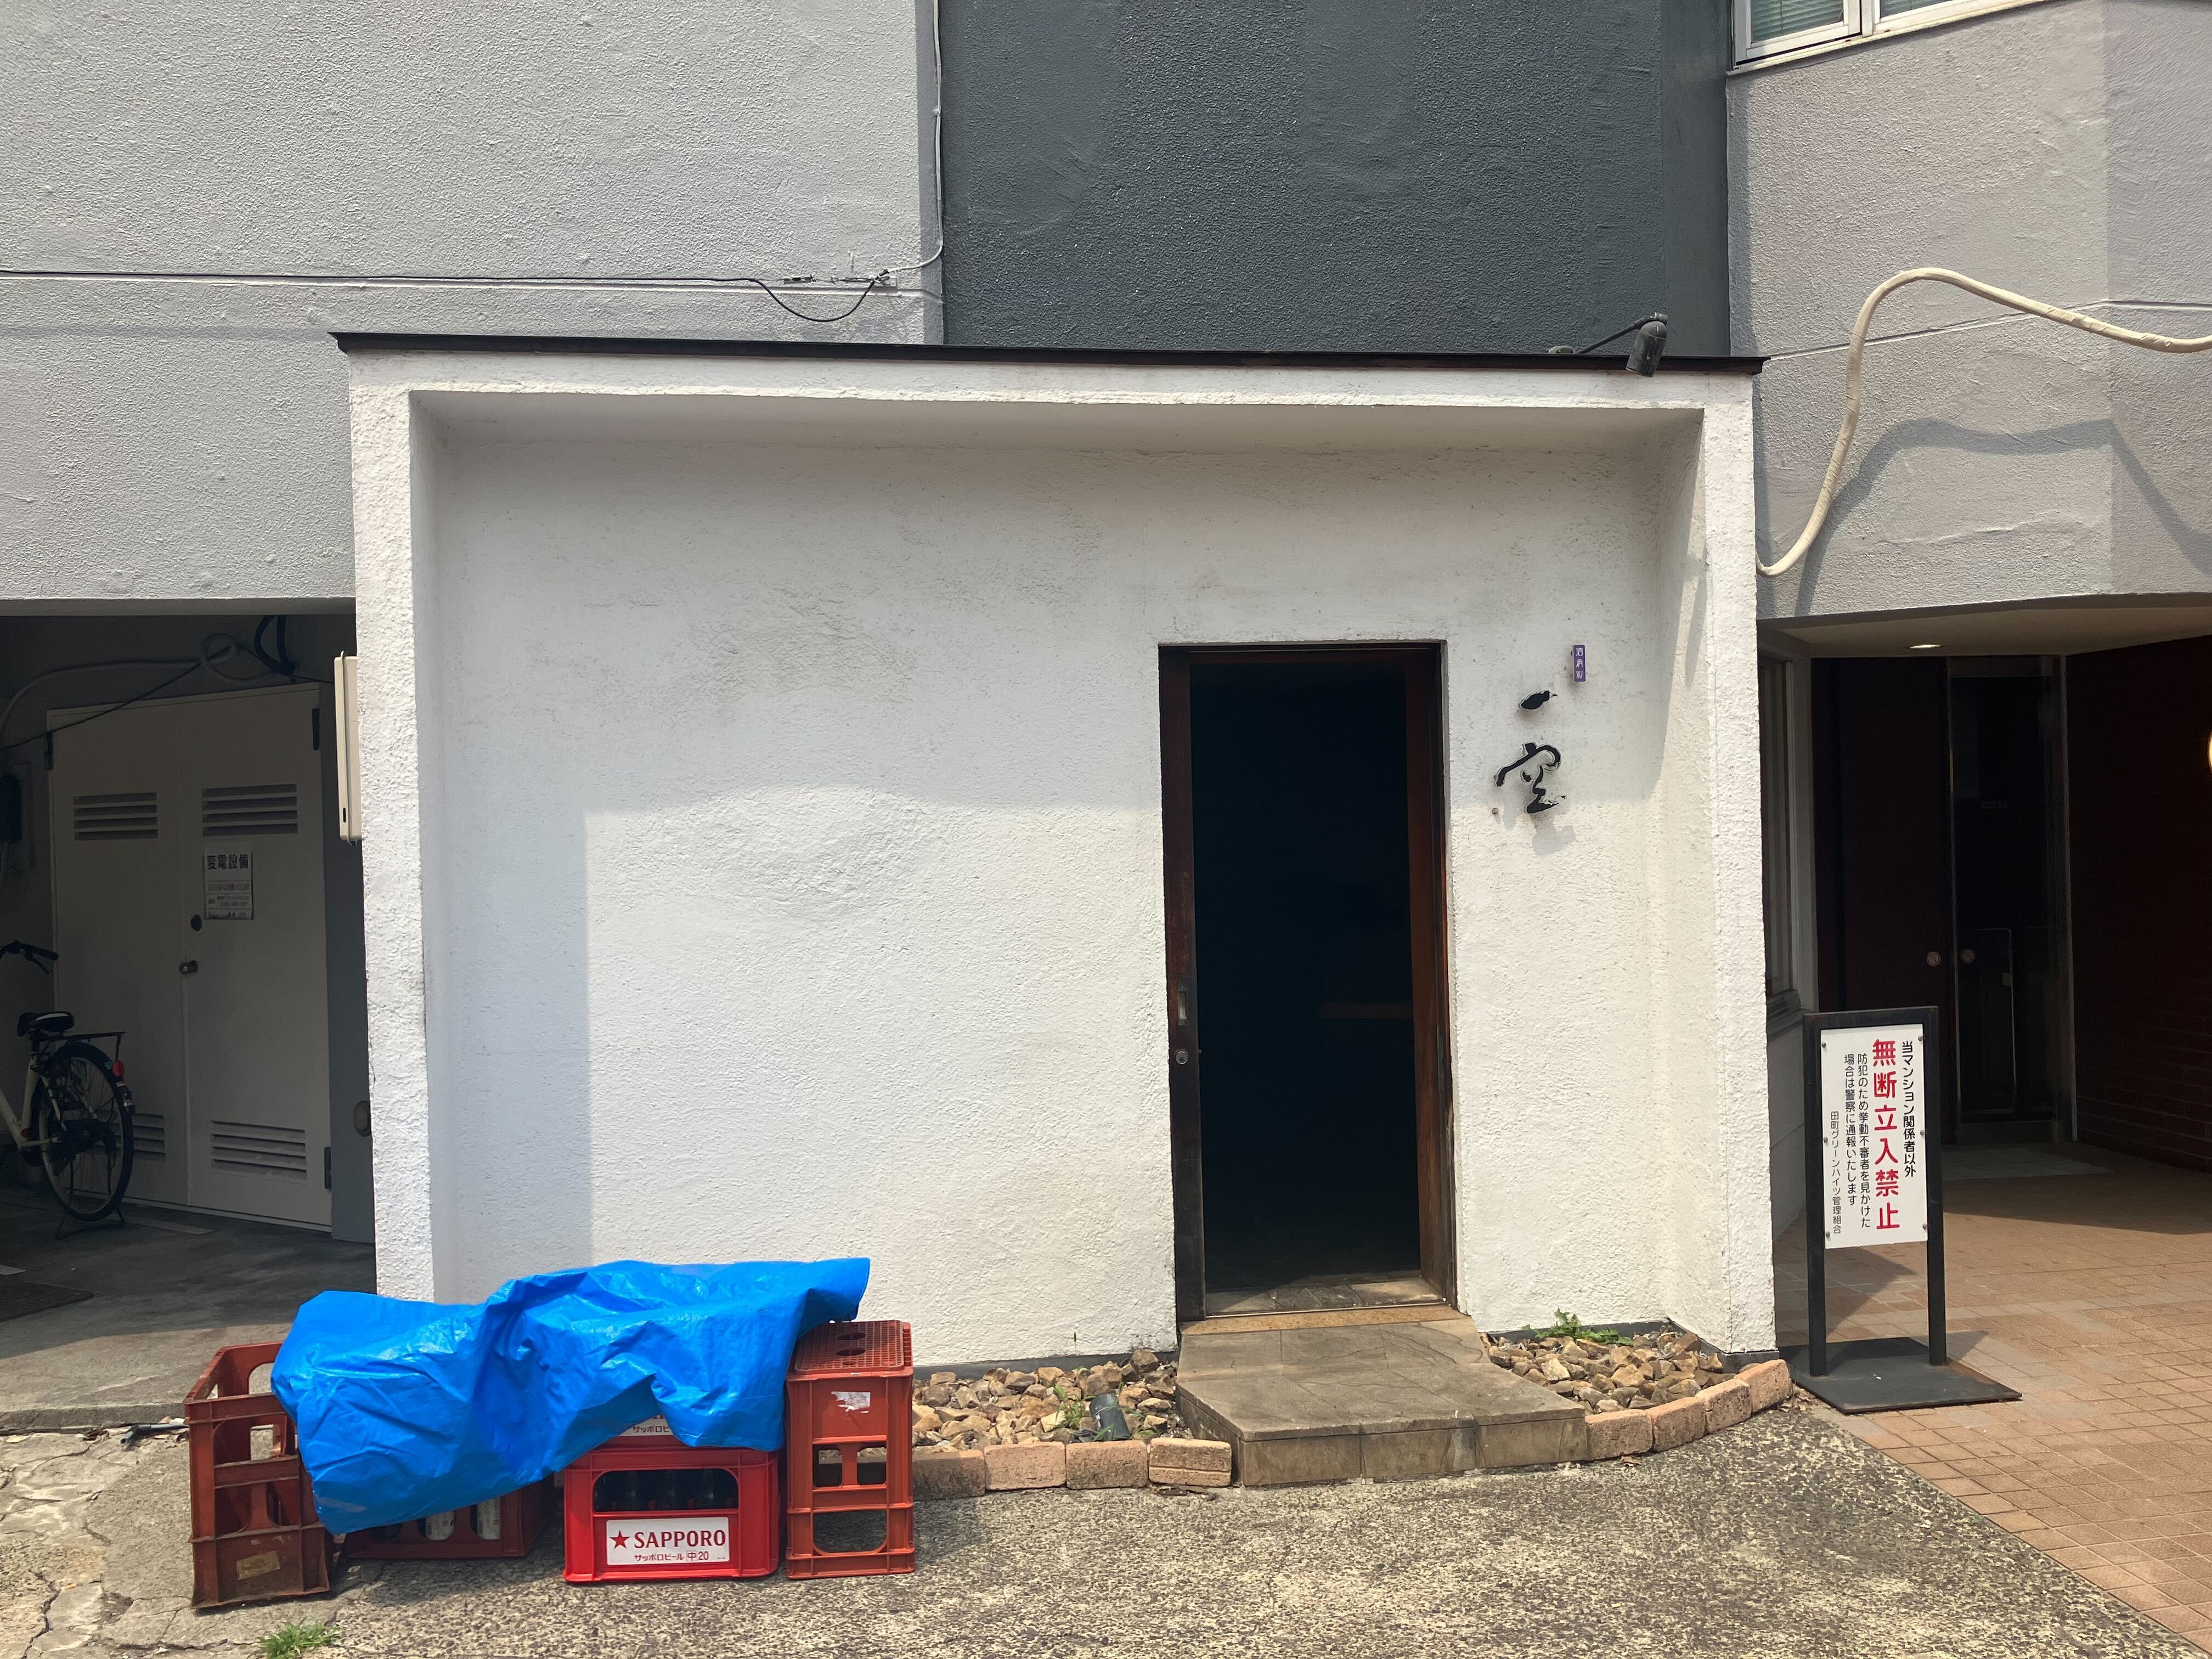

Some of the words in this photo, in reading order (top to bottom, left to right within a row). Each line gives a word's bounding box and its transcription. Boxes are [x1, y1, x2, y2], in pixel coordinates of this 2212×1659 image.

[1830, 1111, 1842, 1234] 田町グリーンハイツ管理組合
[1844, 1053, 1858, 1206] 場合は警察に通報いたします
[1857, 1053, 1871, 1228] 防犯のため挙動不審者を見かけた
[1872, 1039, 1900, 1230] 無断立入禁止
[1901, 1040, 1916, 1178] 当マンション関係者以外
[634, 1530, 726, 1548] SAPPORO
[634, 1553, 684, 1561] サッポロビール
